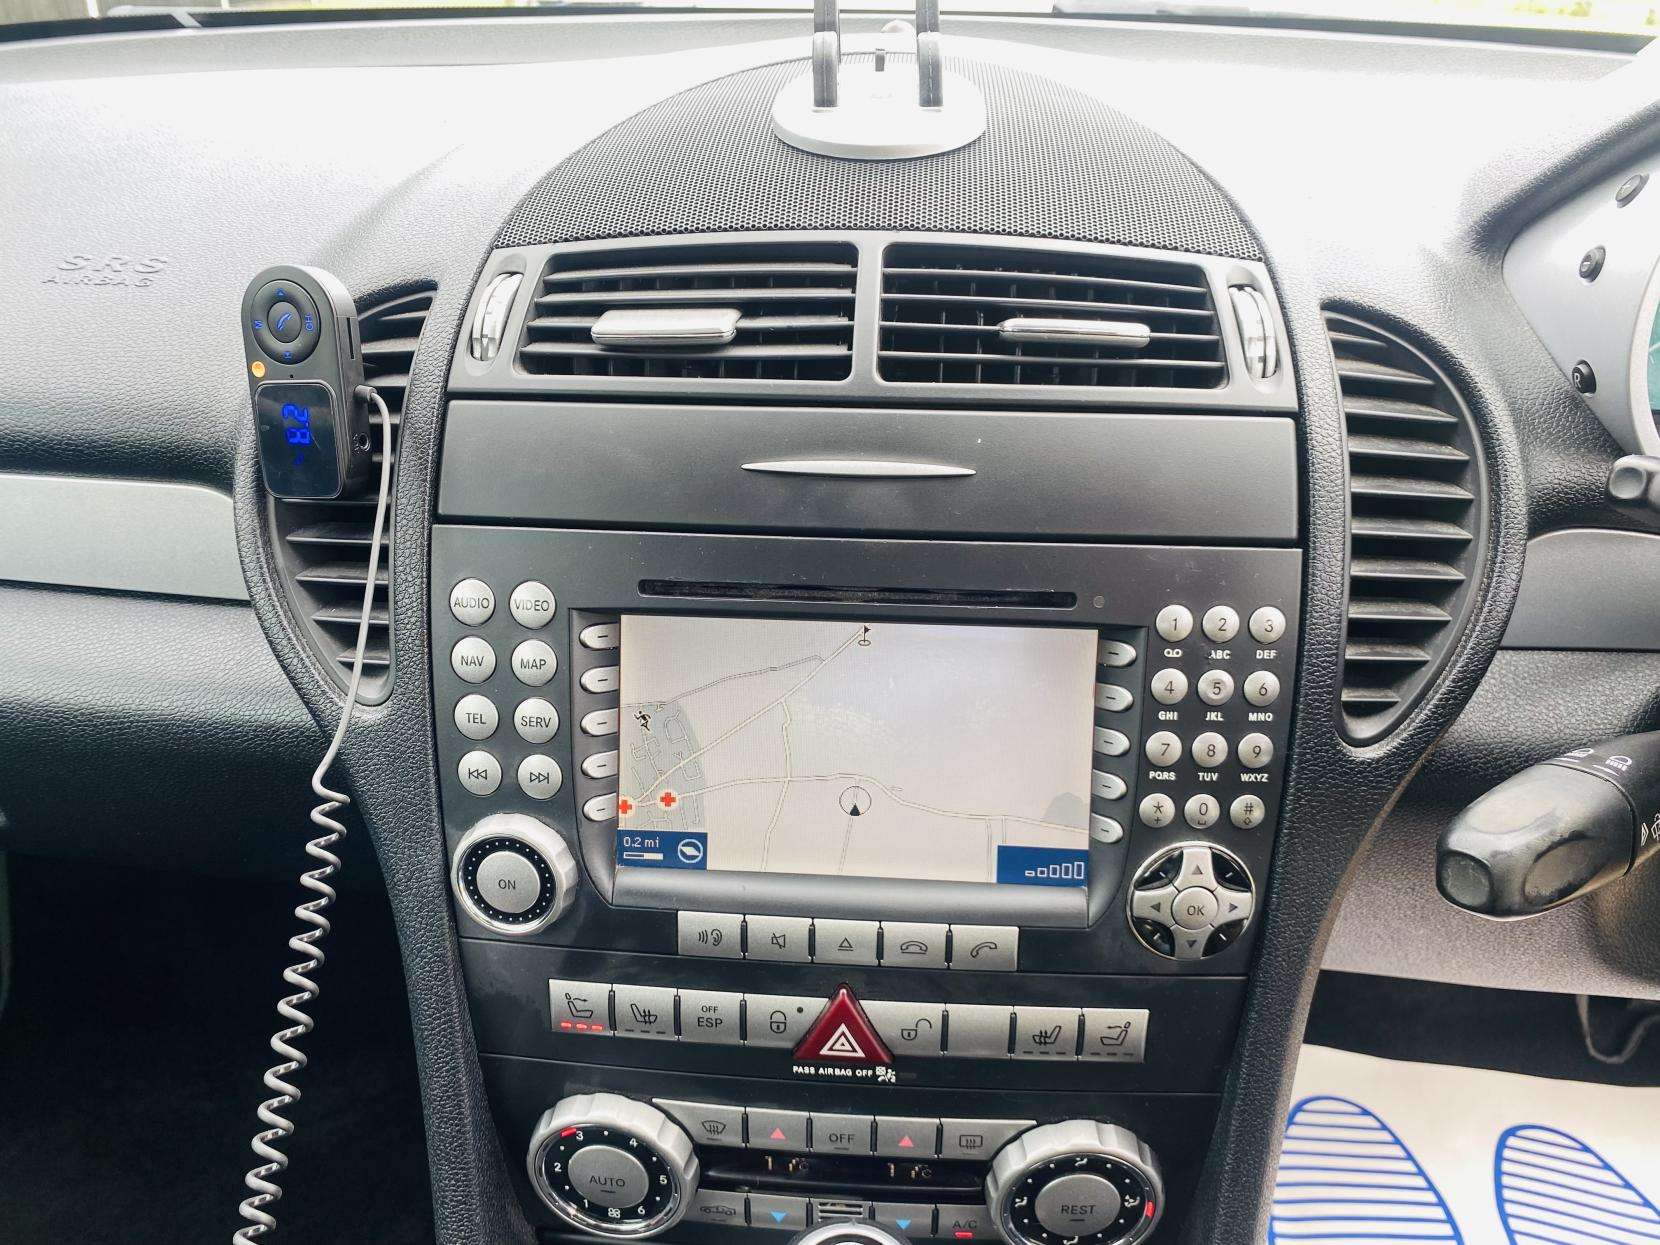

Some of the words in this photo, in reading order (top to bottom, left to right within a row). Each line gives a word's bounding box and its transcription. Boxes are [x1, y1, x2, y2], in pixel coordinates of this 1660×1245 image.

[57, 255, 167, 273] SRS
[42, 274, 153, 287] AIRBAG
[1573, 372, 1581, 388] R
[453, 597, 490, 609] AUDIO
[514, 598, 549, 612] VIDEO
[1171, 617, 1178, 632] 1
[1217, 617, 1227, 632] 2
[1264, 618, 1274, 633] 3
[460, 655, 485, 667] NAV
[1208, 650, 1232, 660] ABC
[1255, 650, 1278, 660] DEF
[519, 657, 547, 670] MAP
[1164, 680, 1175, 694] 4
[1211, 681, 1222, 695] 5
[1258, 682, 1268, 696] 6
[465, 712, 486, 725] TEL
[520, 714, 552, 728] SERV
[1158, 711, 1178, 721] GHI
[1205, 711, 1224, 721] JKL
[1248, 712, 1273, 722] MNO
[1160, 743, 1170, 757] 7
[1206, 743, 1216, 757] 8
[1252, 745, 1262, 759] 9
[1149, 771, 1176, 780] PQRS
[1198, 772, 1218, 781] TUV
[1240, 773, 1269, 782] WXYZ
[1199, 802, 1208, 816] 0
[623, 836, 641, 848] 0.2
[644, 836, 661, 848] mi
[498, 878, 516, 890] ON
[1186, 905, 1205, 916] OK
[701, 1005, 719, 1013] OFF
[697, 1016, 723, 1028] ESP
[792, 1065, 816, 1075] PASS
[818, 1067, 853, 1077] AIRBAG
[855, 1069, 873, 1077] OFF
[575, 1130, 584, 1141] 3
[828, 1132, 856, 1144] OFF
[629, 1137, 638, 1148] 4
[554, 1162, 562, 1172] 2
[589, 1175, 626, 1187] AUTO
[659, 1175, 668, 1184] 5
[583, 1199, 589, 1208] 1
[637, 1206, 646, 1215] 6
[1060, 1204, 1096, 1216] REST
[952, 1218, 978, 1230] A/C
